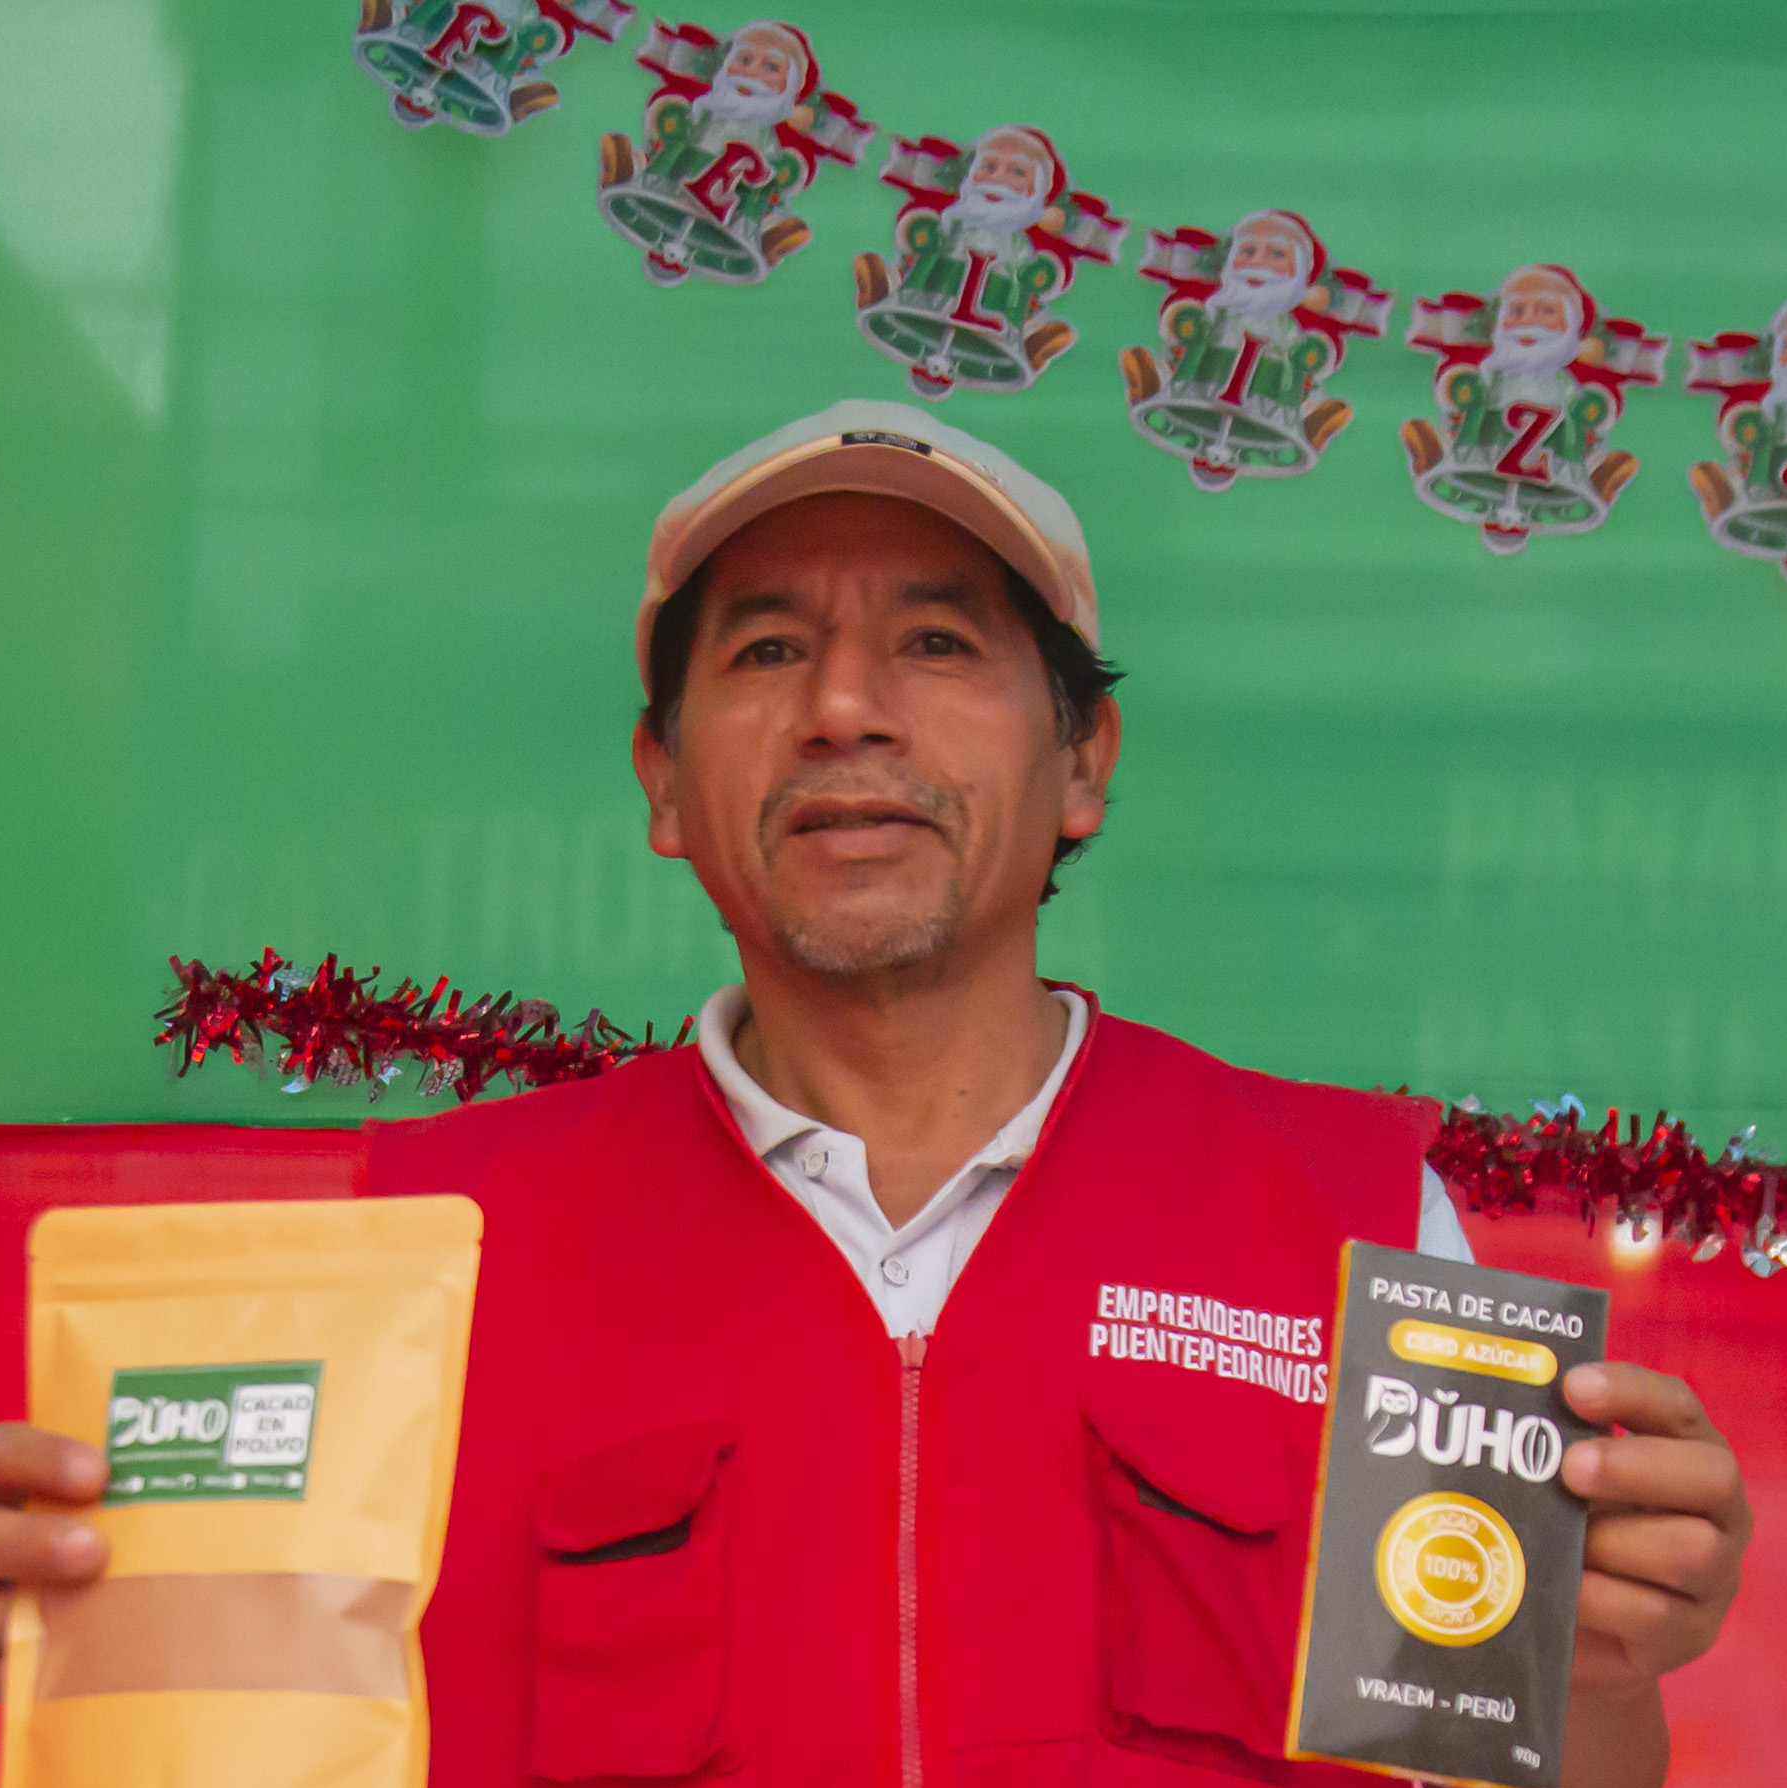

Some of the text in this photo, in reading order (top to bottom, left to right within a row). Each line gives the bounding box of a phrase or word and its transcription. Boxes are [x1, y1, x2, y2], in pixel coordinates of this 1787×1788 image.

[1097, 1284, 1324, 1357] EMPRENDEDORES
[1369, 1276, 1584, 1339] PASTA DE CACAO
[1088, 1322, 1329, 1405] PUENTEPEDRINOS
[1404, 1330, 1460, 1357] CERO
[1424, 1553, 1479, 1585] 100%
[1356, 1675, 1435, 1710] VRAEM
